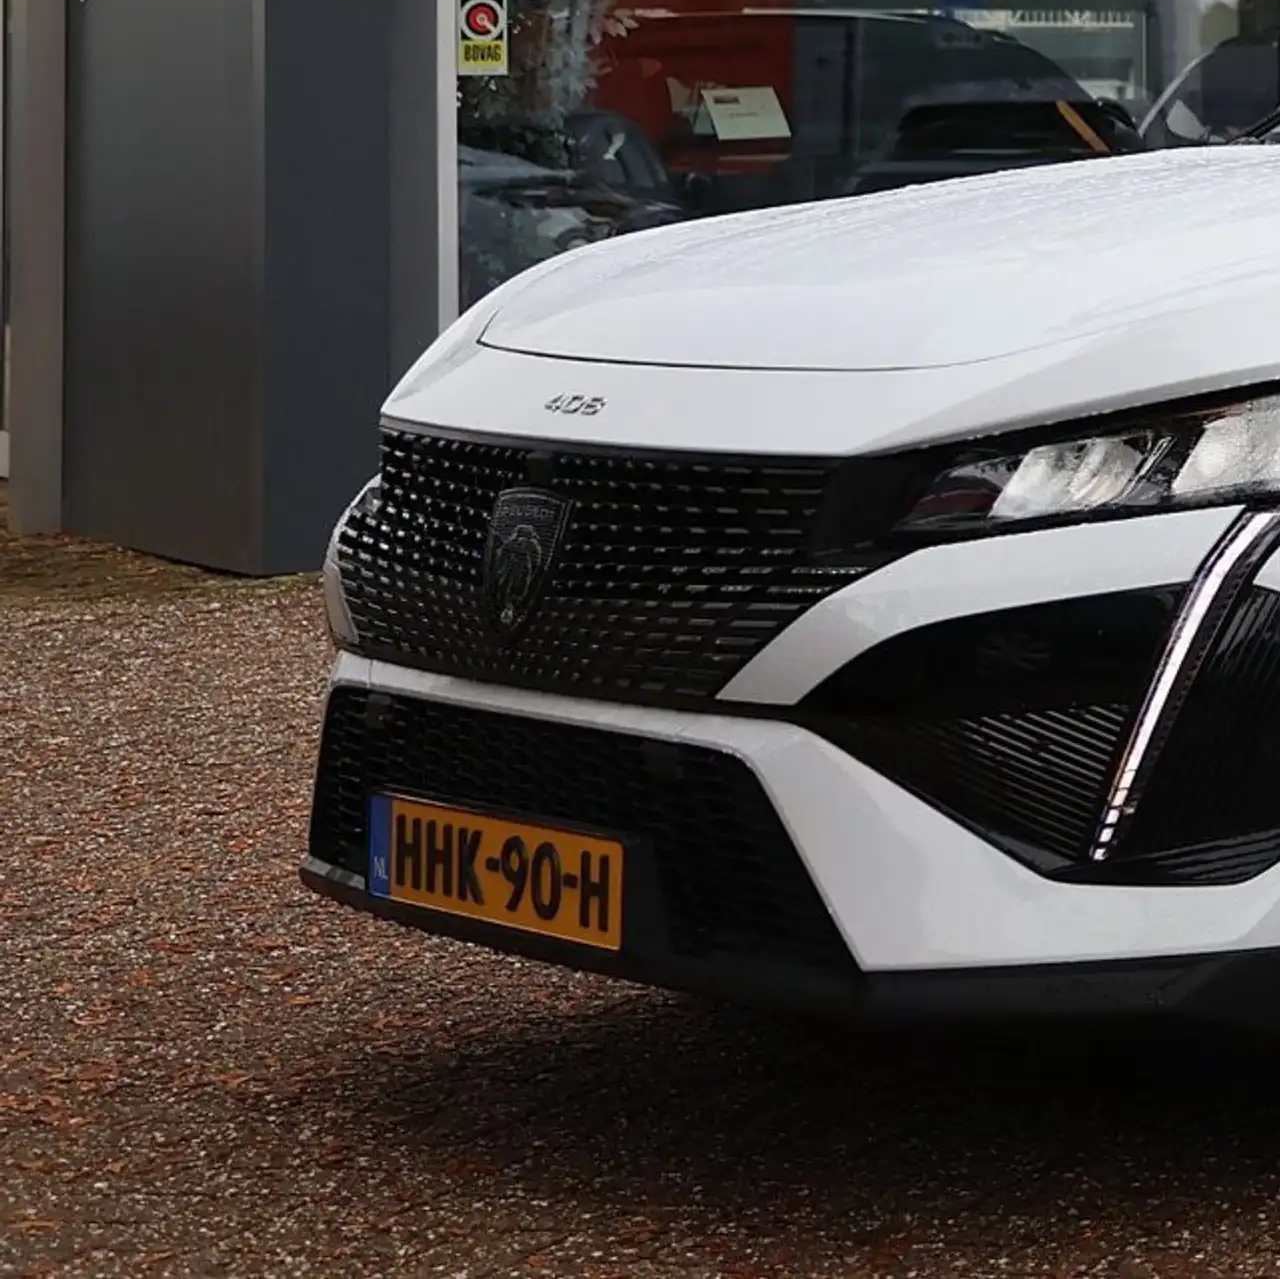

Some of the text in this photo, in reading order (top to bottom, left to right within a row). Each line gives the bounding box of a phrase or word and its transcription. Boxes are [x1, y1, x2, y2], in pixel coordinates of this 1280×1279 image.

[464, 44, 501, 62] BOVAG
[373, 855, 388, 879] NL
[395, 813, 610, 933] HHK-90-H
